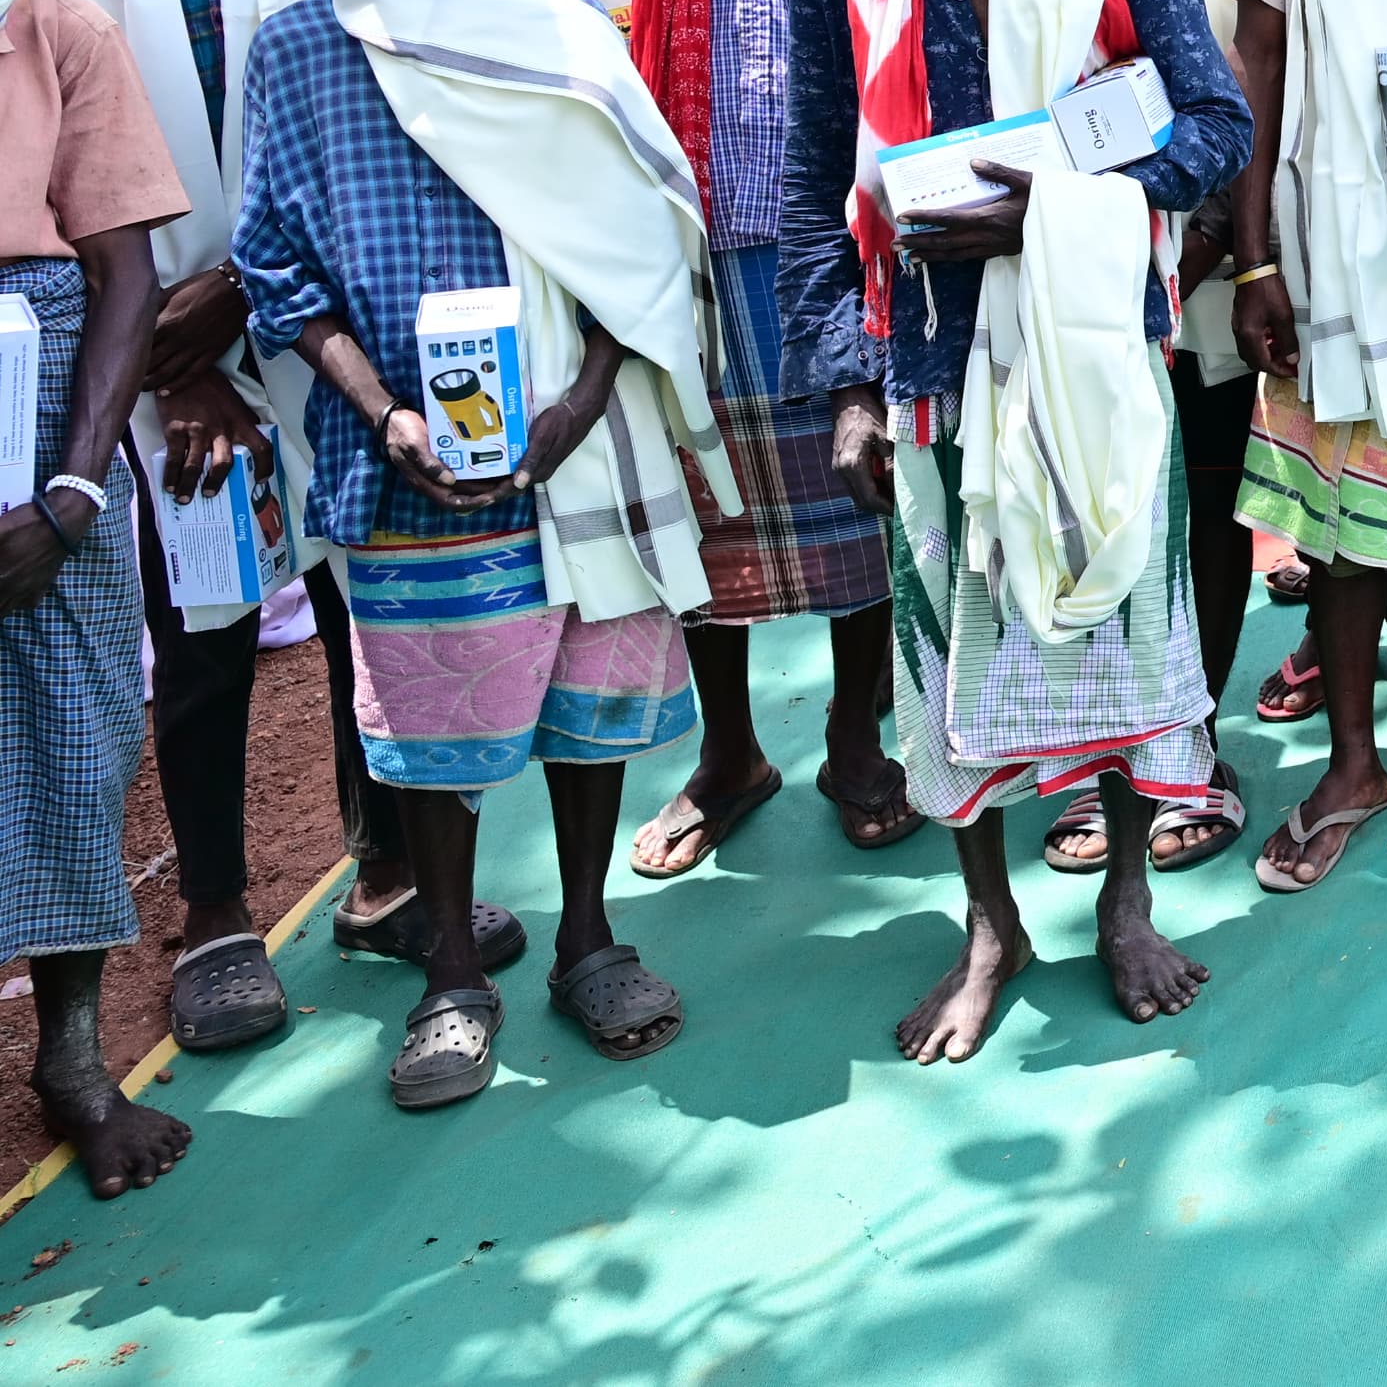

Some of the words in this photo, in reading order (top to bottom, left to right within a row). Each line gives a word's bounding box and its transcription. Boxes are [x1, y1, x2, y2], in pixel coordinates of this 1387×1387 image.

[1085, 109, 1104, 149] Osring
[505, 386, 518, 416] Osring
[236, 513, 248, 542] Osring
